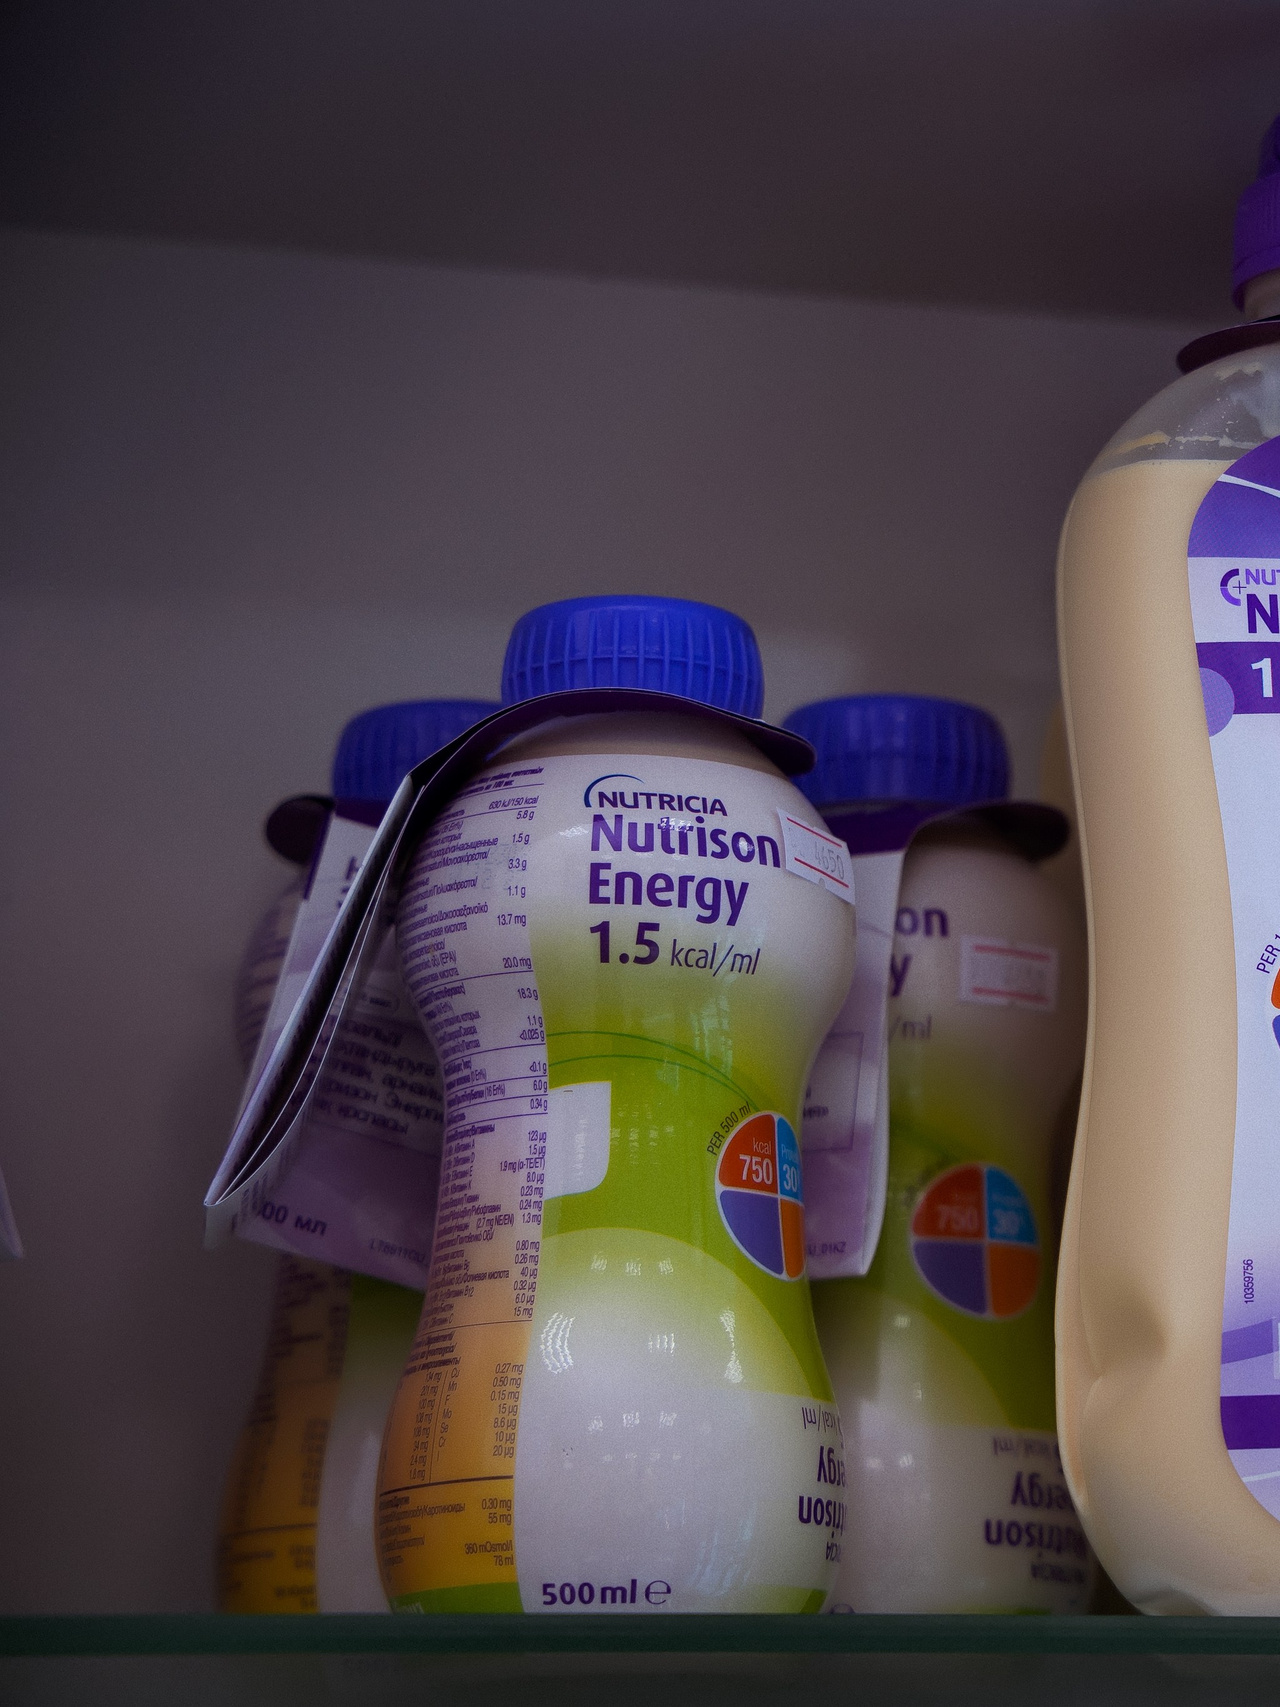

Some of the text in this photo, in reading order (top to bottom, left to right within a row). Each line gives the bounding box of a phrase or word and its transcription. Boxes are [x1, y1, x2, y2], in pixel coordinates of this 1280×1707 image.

[598, 791, 728, 817] NUTRICIA
[590, 814, 781, 868] Nutrison
[589, 862, 749, 926] Energy
[497, 914, 512, 926] 13.7
[590, 920, 761, 977] 1.5 kcal/ml
[1256, 947, 1279, 975] PER
[503, 957, 518, 968] 20.0
[706, 1101, 752, 1157] PER 500 ml
[753, 1138, 772, 1155] kcal
[739, 1154, 773, 1185] 750
[1243, 1258, 1254, 1304] 10359756
[509, 1376, 521, 1388] mg
[511, 1363, 524, 1375] mg
[507, 1390, 520, 1402] mg
[481, 1498, 512, 1511] 0.30 mg
[488, 1512, 512, 1525] 55 mg
[542, 1582, 595, 1605] 500
[600, 1579, 637, 1604] ml
